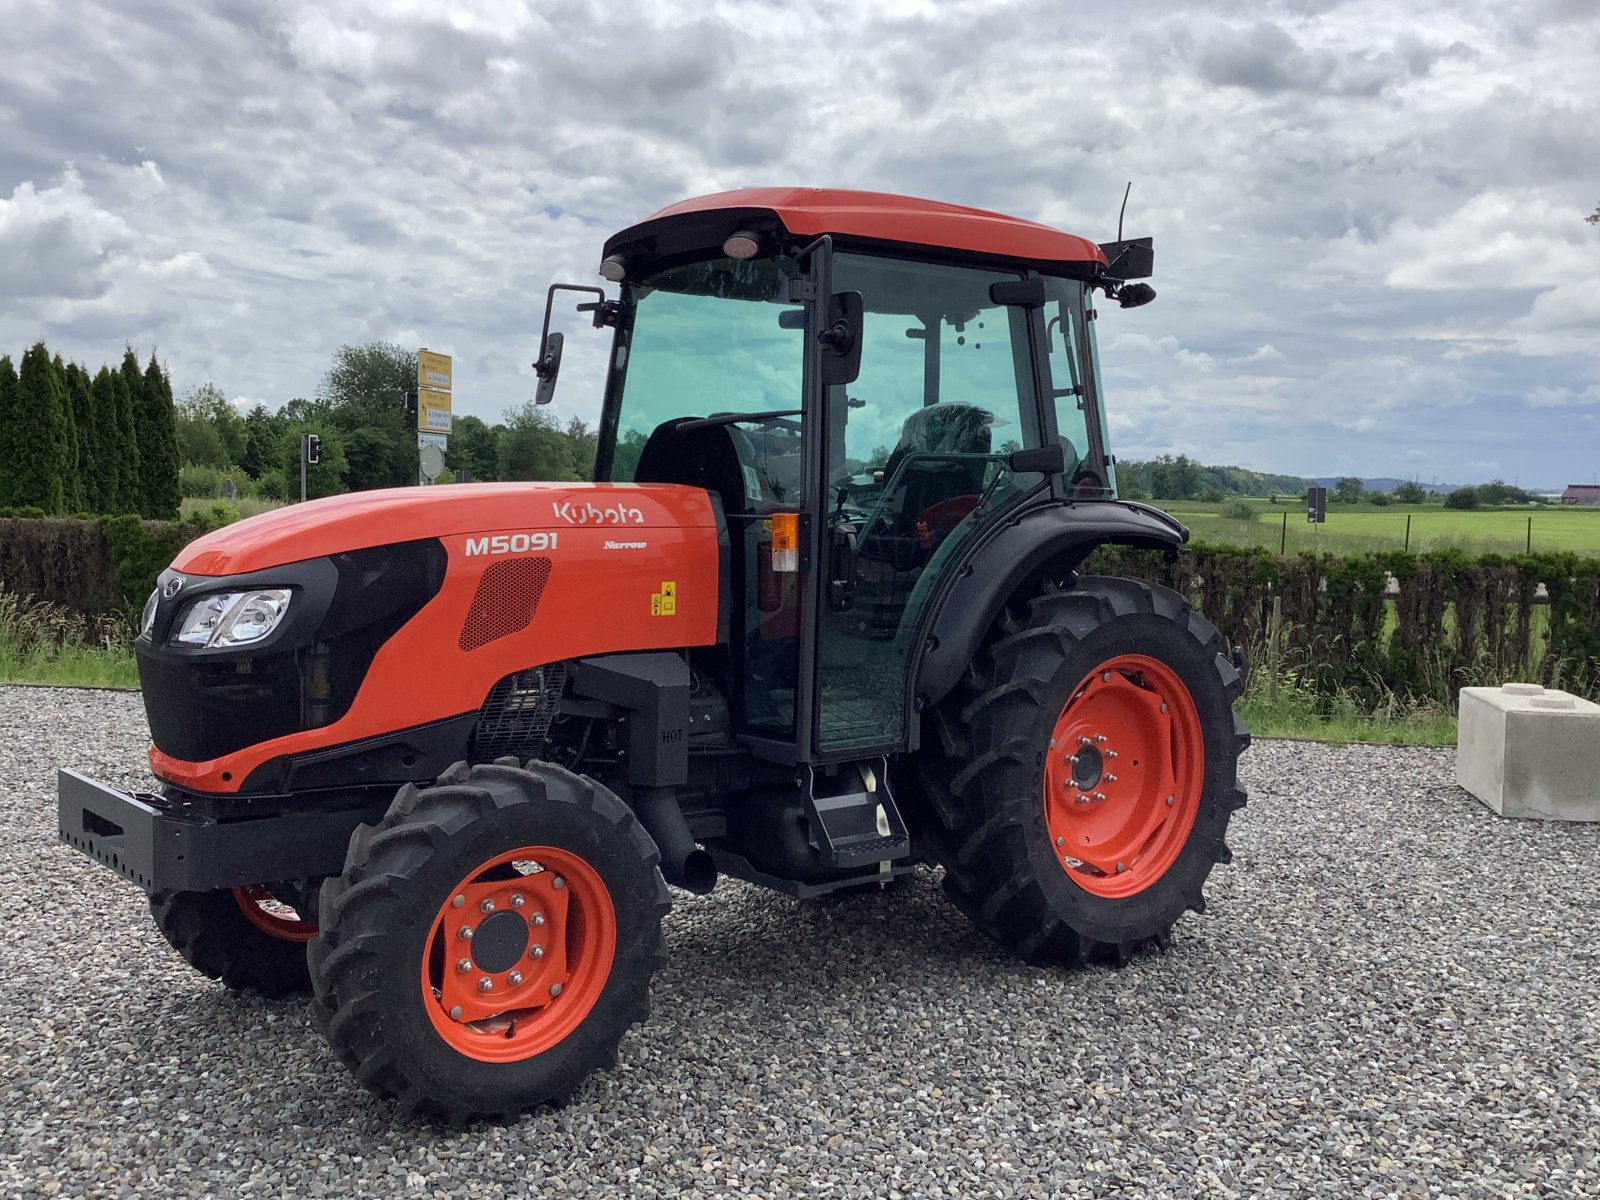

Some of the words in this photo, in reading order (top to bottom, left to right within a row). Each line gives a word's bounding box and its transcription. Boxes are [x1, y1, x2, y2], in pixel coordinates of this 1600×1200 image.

[552, 502, 645, 524] Kubota
[465, 532, 558, 557] M5091
[603, 540, 647, 550] Narrow
[663, 729, 683, 743] HOT
